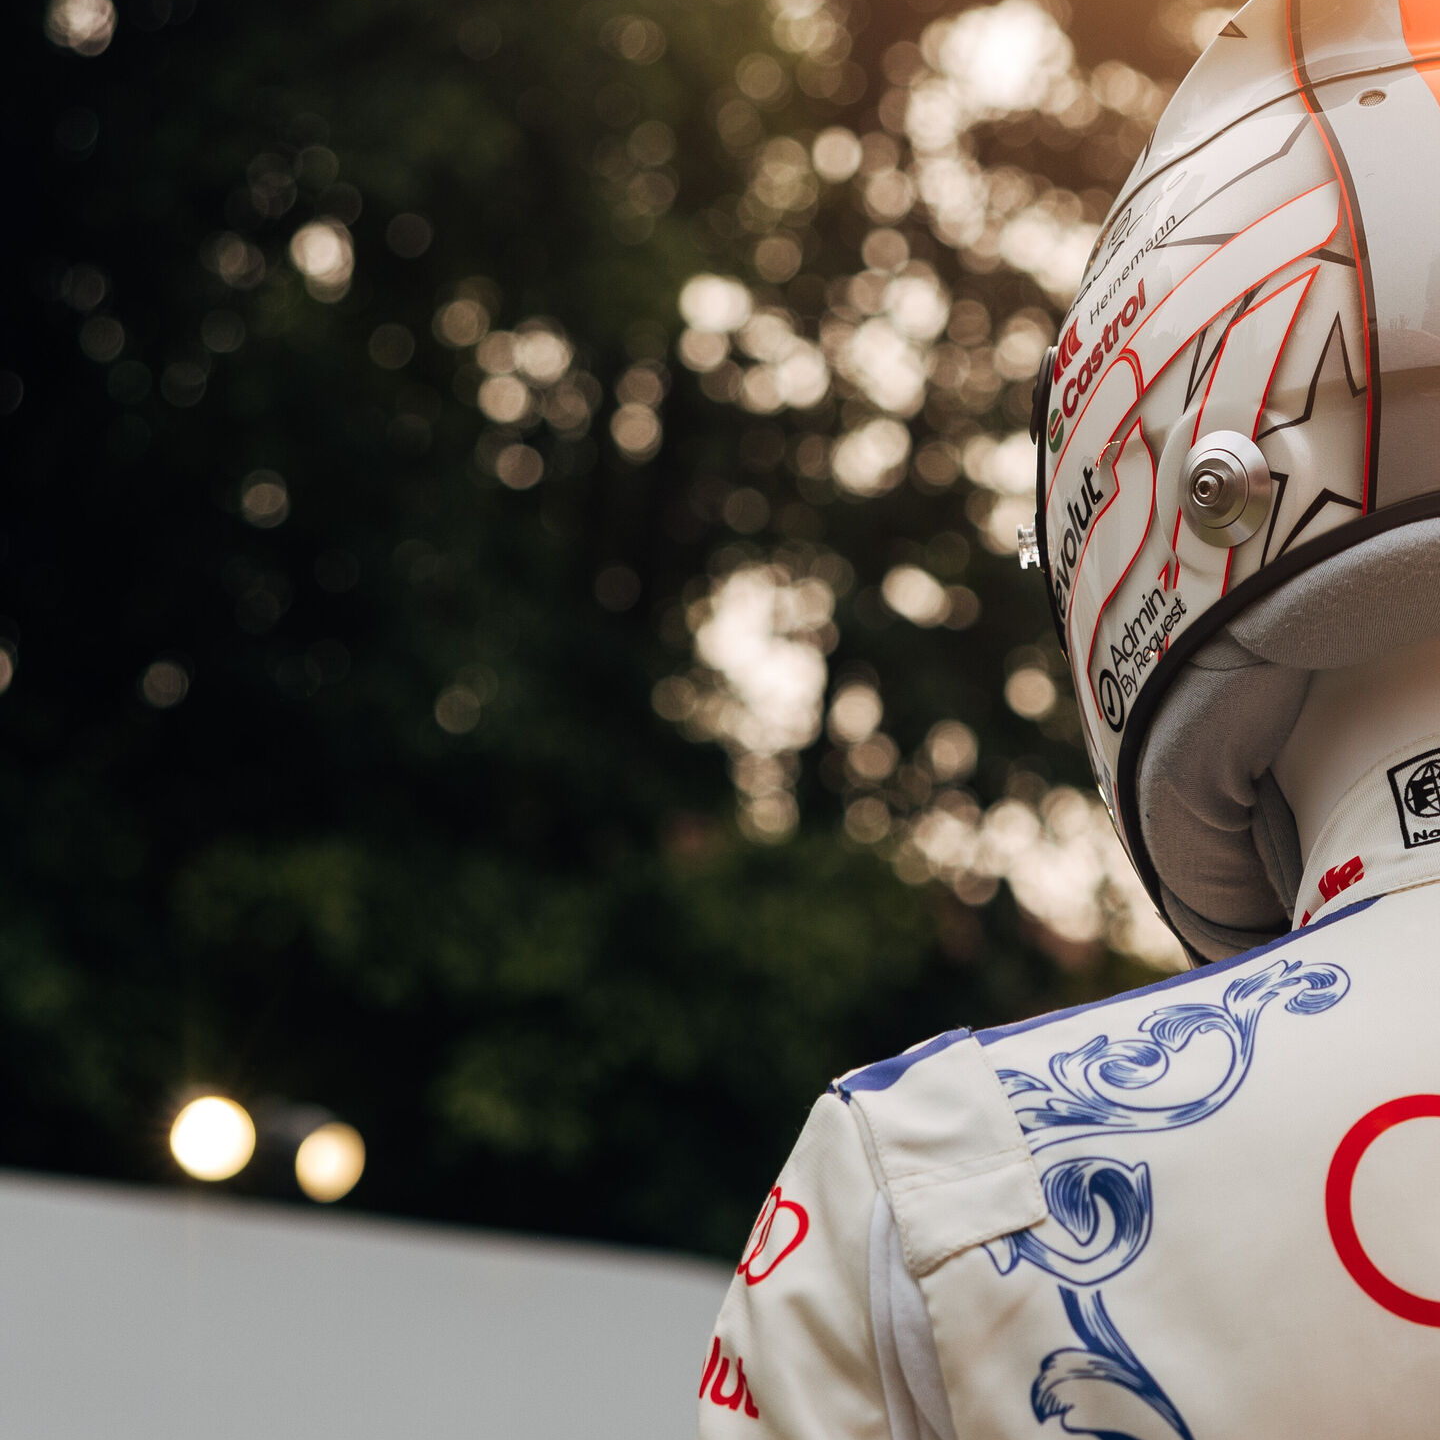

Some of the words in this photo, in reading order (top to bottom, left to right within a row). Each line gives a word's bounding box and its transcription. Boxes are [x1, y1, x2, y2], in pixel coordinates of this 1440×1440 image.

[1089, 215, 1176, 325] Heinemann
[1062, 277, 1146, 418] Castrol
[1053, 465, 1104, 621] evolut
[1110, 588, 1167, 675] Admin
[1120, 667, 1138, 699] By
[1135, 597, 1187, 675] Request
